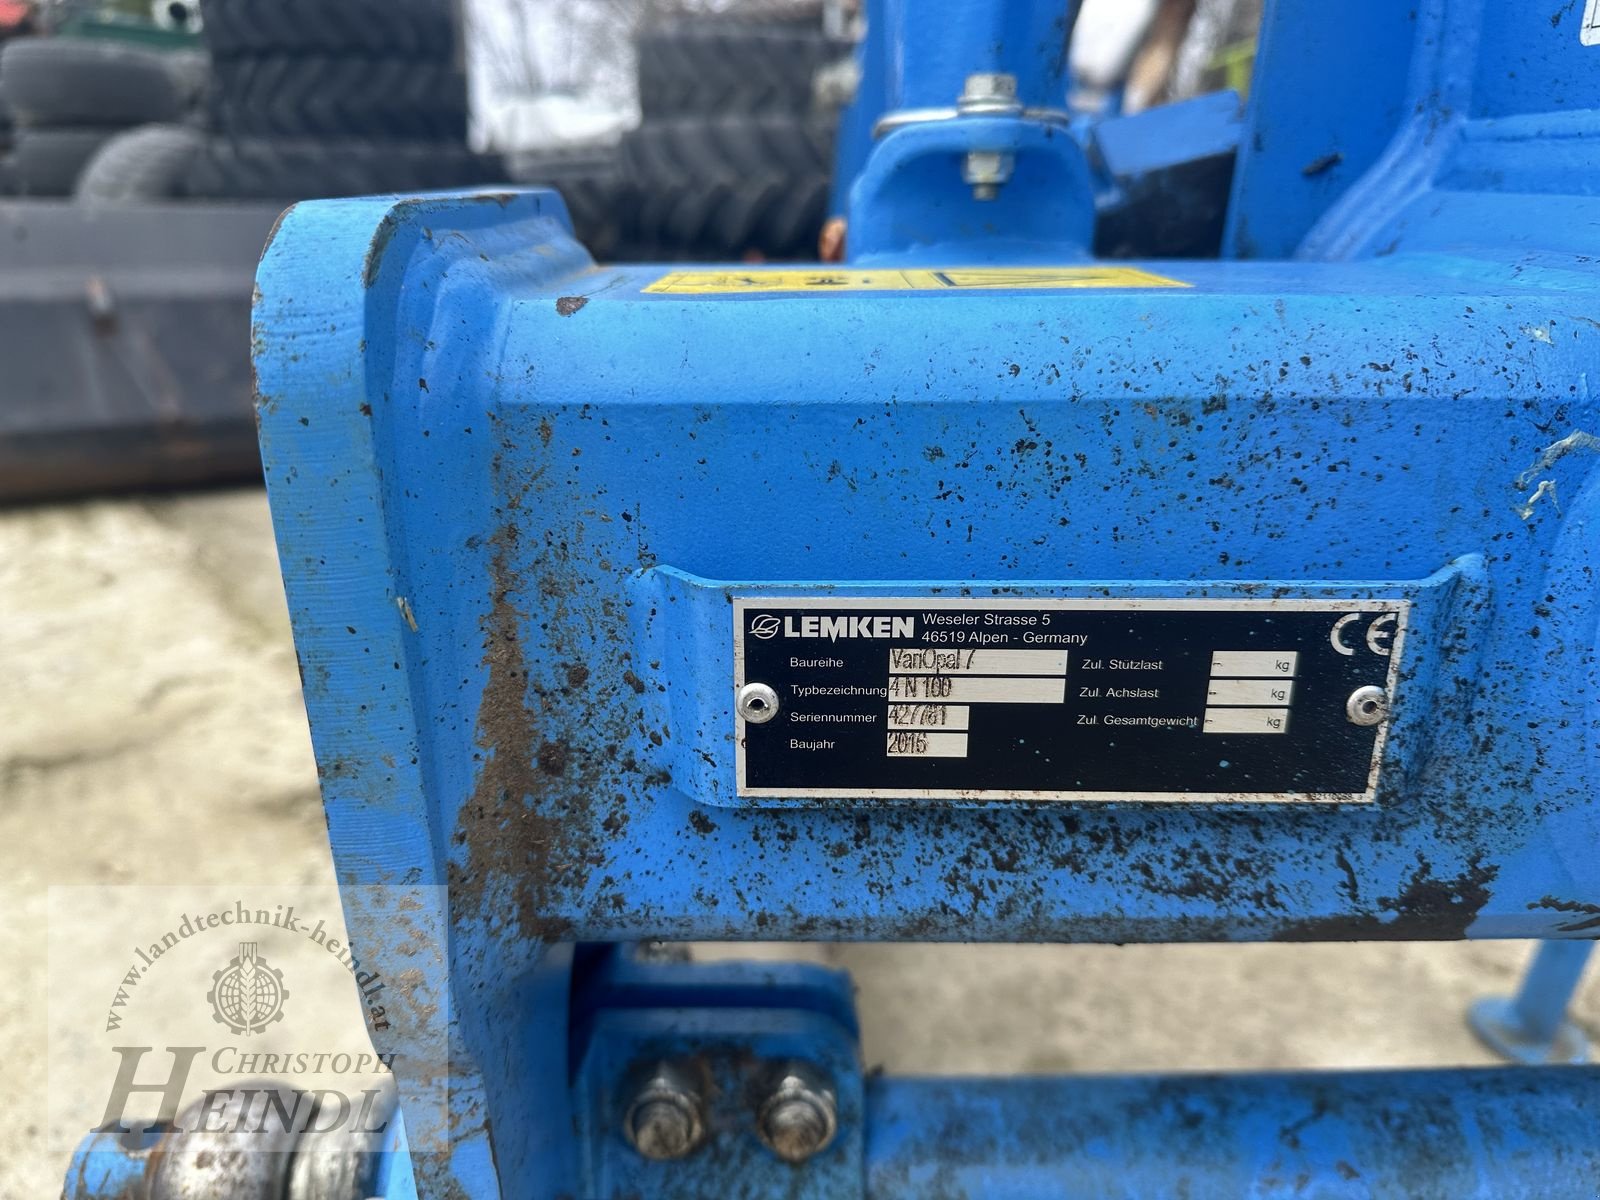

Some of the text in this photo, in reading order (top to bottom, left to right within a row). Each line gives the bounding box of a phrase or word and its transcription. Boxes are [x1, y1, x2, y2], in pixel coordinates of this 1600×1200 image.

[922, 613, 1051, 626] Weseler Strasse 5
[784, 616, 915, 643] LEMKEN
[1330, 612, 1397, 656] CE
[921, 631, 966, 644] 46519
[968, 631, 1009, 646] Alpen
[1022, 631, 1089, 647] Germany
[789, 657, 844, 668] Baureihe
[891, 649, 977, 674] VariOpal 7
[1081, 659, 1164, 671] Zul. Stützlast
[1275, 659, 1291, 673] kg
[790, 684, 888, 699] Typbezeichnung
[890, 676, 953, 698] 4 N 100
[1079, 687, 1160, 698] Zul. Achslast
[1270, 688, 1286, 701] kg
[789, 712, 878, 724] Seriennummer
[1076, 715, 1200, 729] Zul. Gesamtgewicht
[1266, 717, 1282, 729] kg
[789, 738, 836, 751] Baujahr
